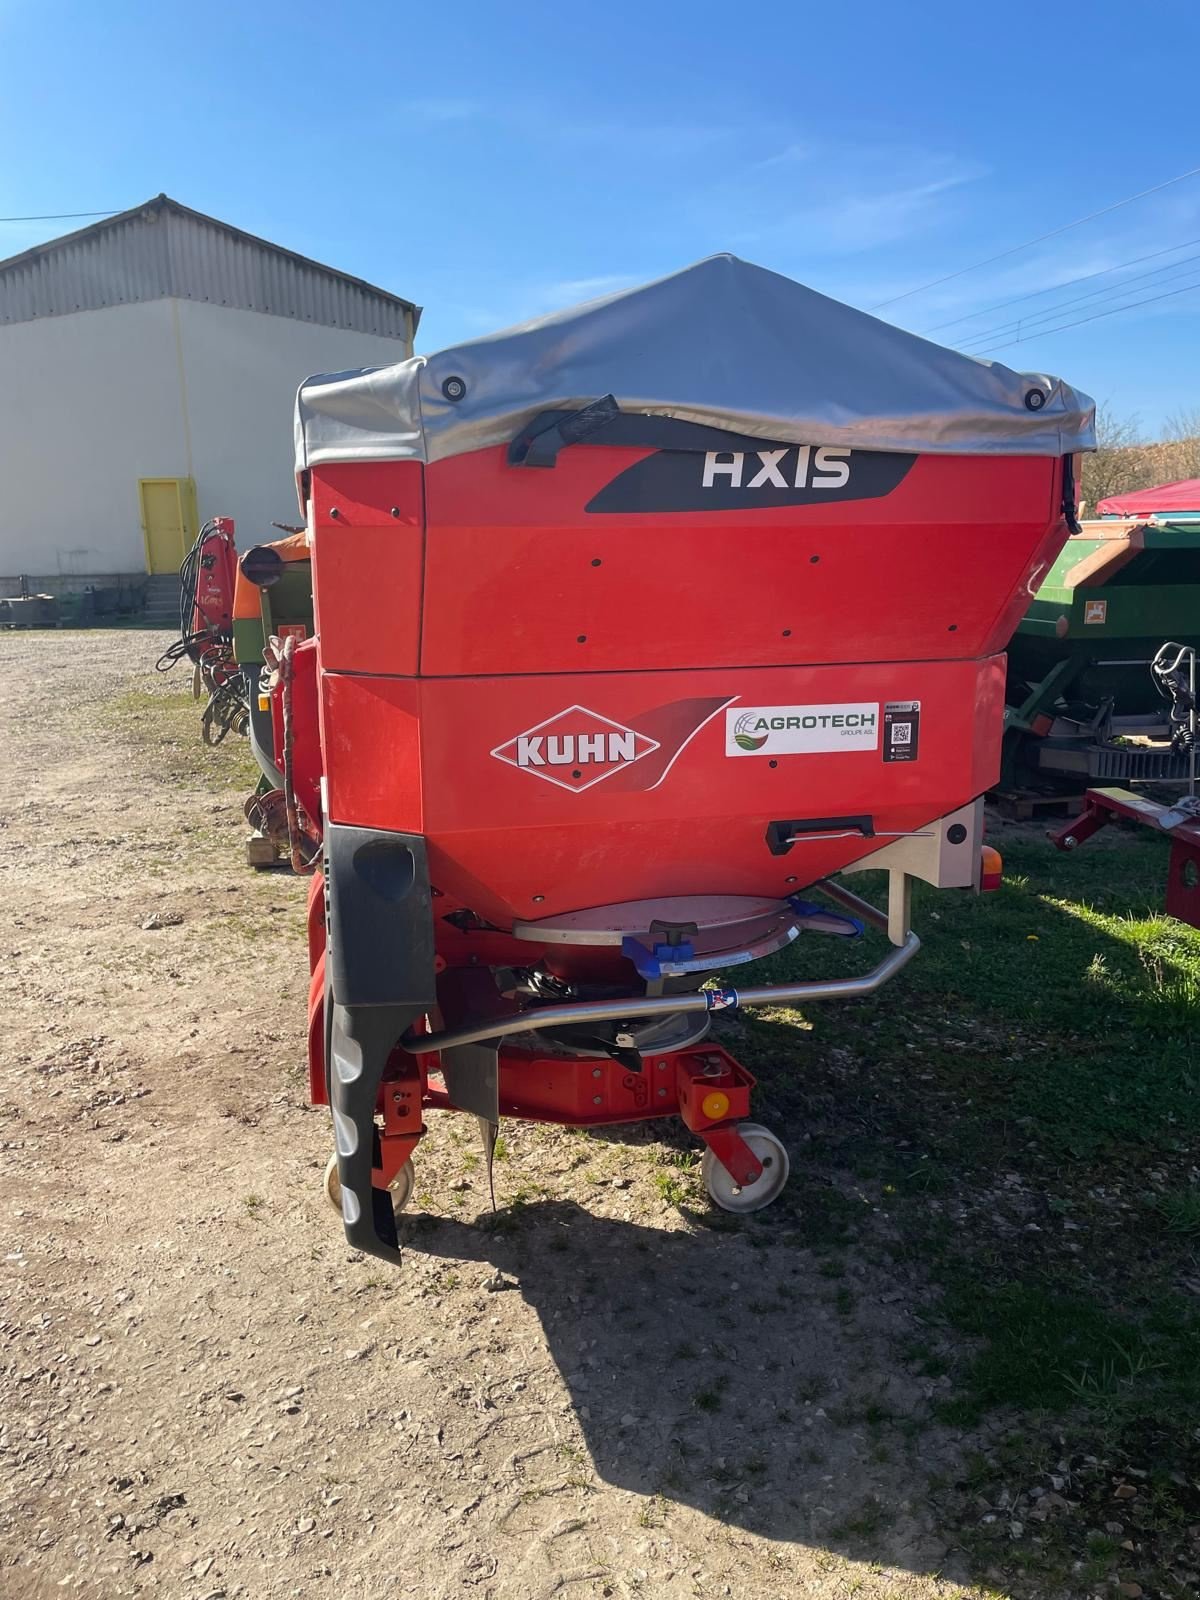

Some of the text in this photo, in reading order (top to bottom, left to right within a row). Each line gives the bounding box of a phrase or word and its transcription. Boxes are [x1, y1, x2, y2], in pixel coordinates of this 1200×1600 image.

[702, 445, 852, 488] AXIS
[753, 713, 875, 731] AGROTECH
[517, 732, 636, 767] KUHN
